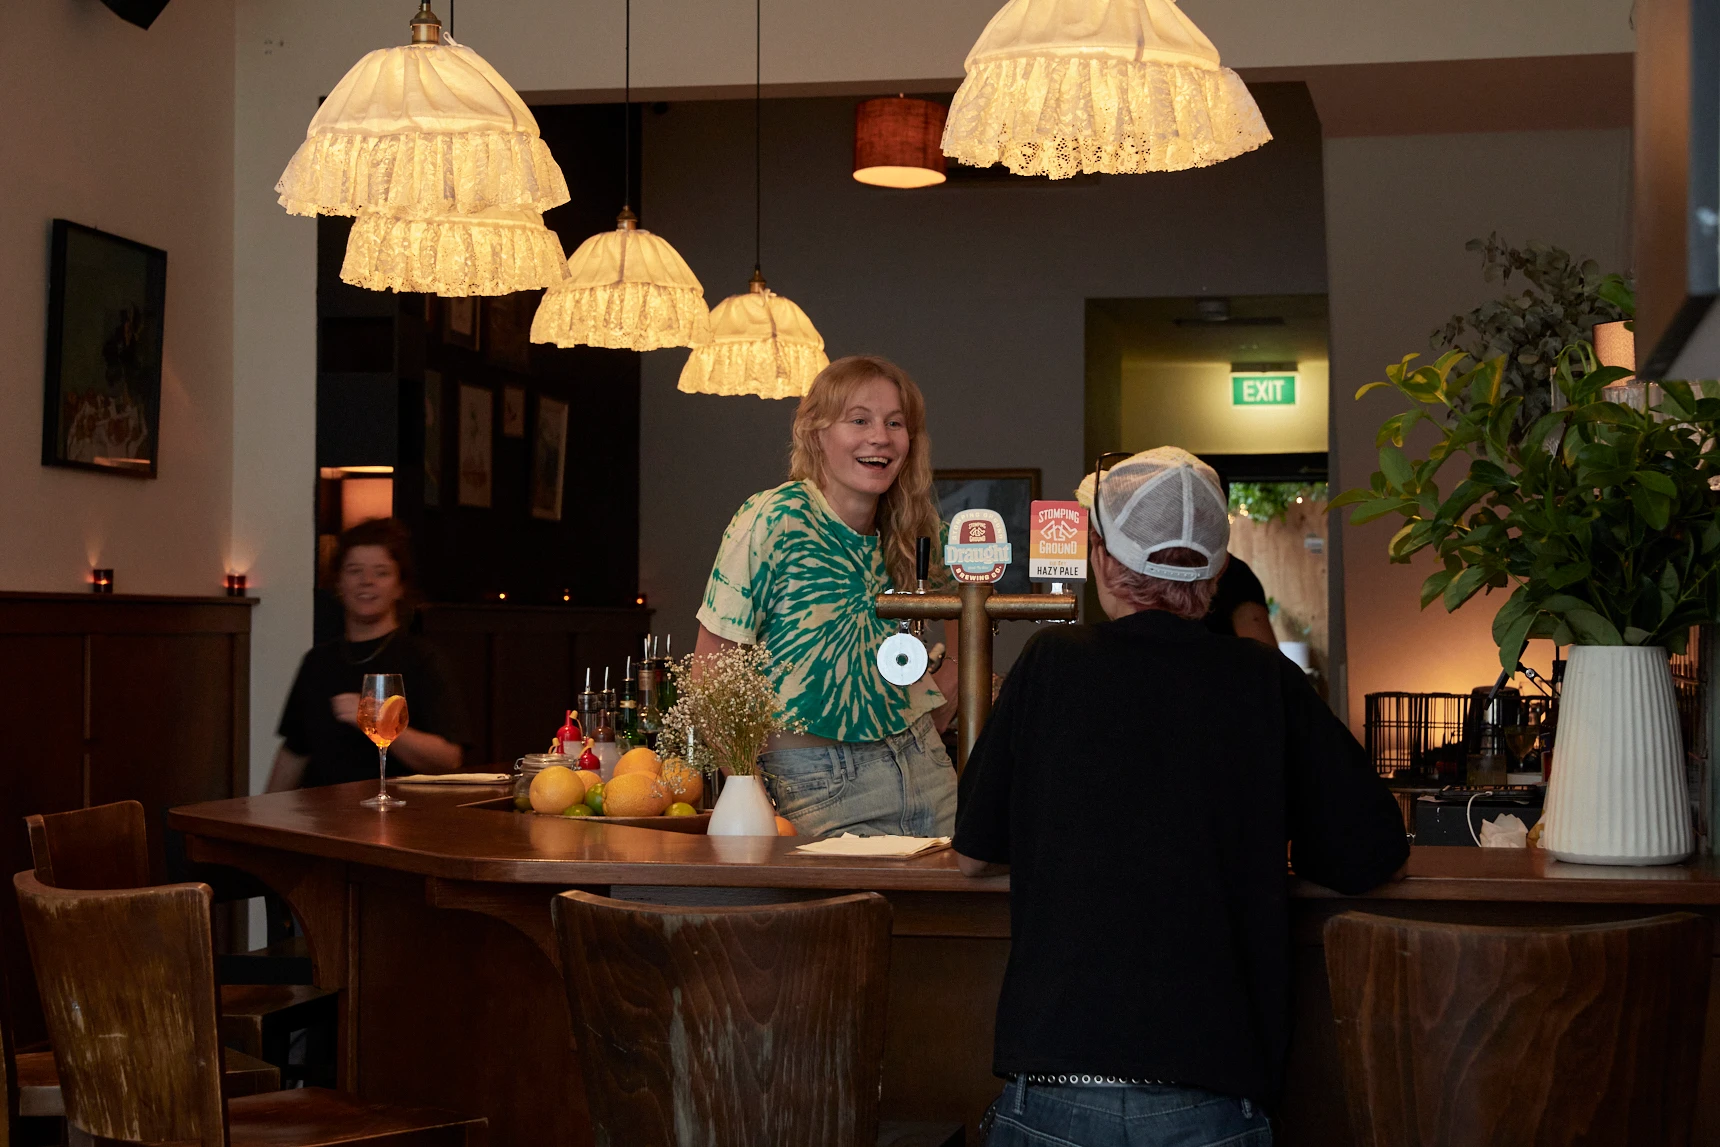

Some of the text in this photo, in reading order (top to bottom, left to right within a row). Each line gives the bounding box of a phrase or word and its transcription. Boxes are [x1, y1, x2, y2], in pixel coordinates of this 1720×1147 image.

[1242, 379, 1285, 402] EXIT
[1038, 508, 1080, 524] STOMPING
[951, 512, 1004, 541] STOMPING GROUND
[946, 544, 1010, 564] Draught
[1039, 540, 1077, 555] GROUND
[955, 567, 990, 581] BREWING
[990, 566, 1002, 579] CO.
[1037, 566, 1079, 576] HAZY PALE
